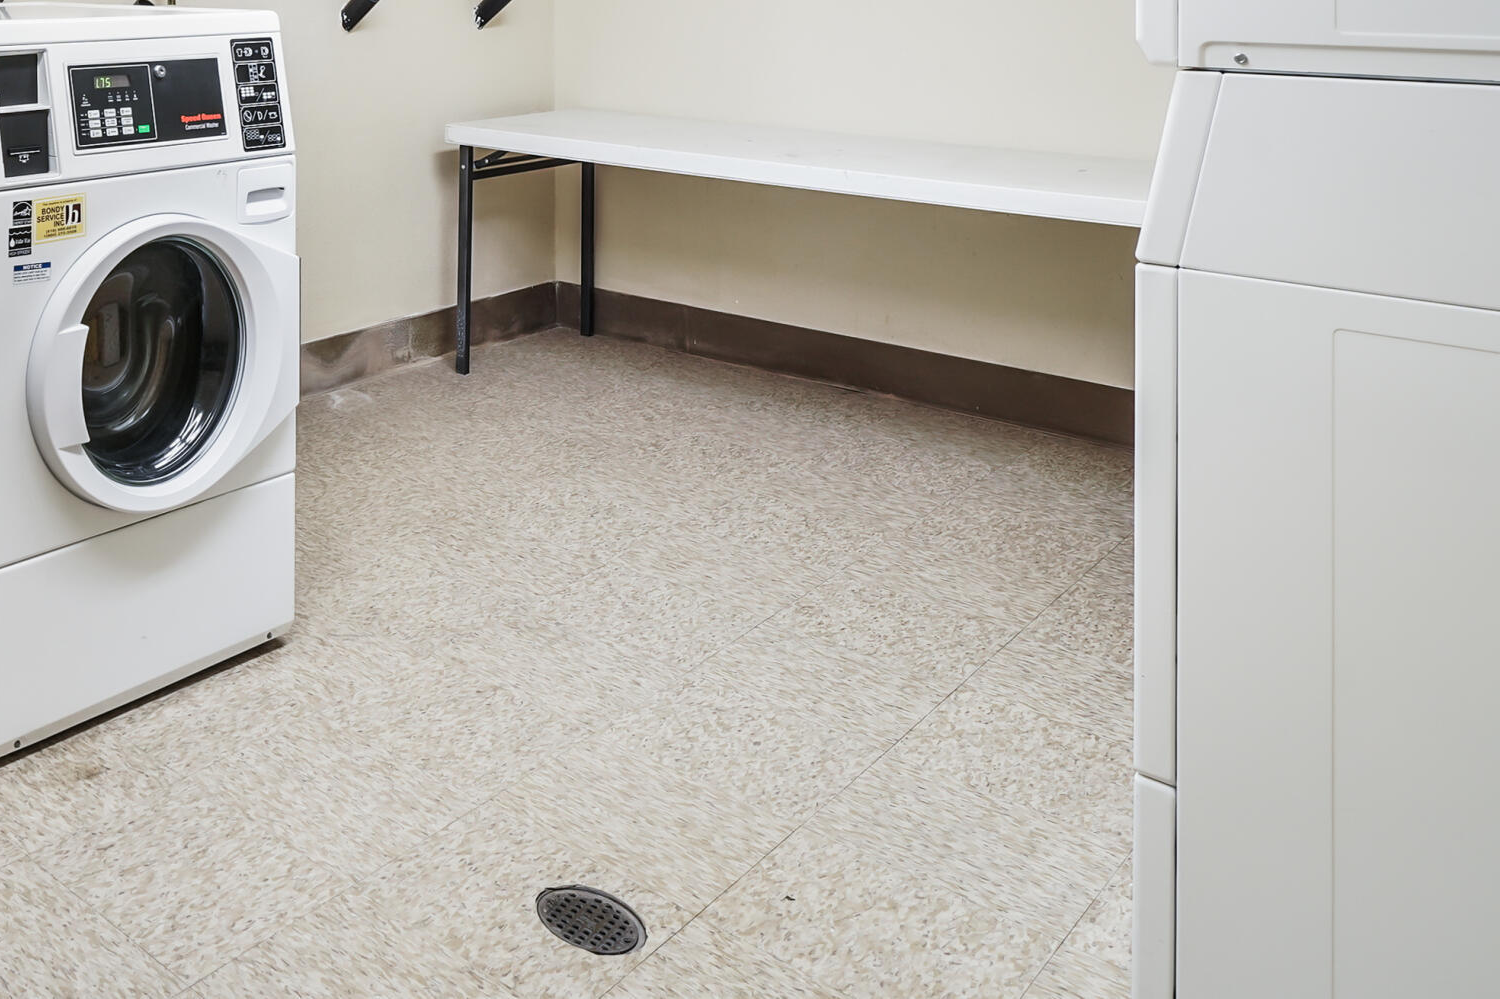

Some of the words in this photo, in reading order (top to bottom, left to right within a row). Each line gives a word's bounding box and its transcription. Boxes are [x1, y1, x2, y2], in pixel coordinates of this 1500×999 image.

[181, 114, 201, 123] Speed
[41, 205, 65, 215] BONDY
[36, 213, 65, 223] SERVICE
